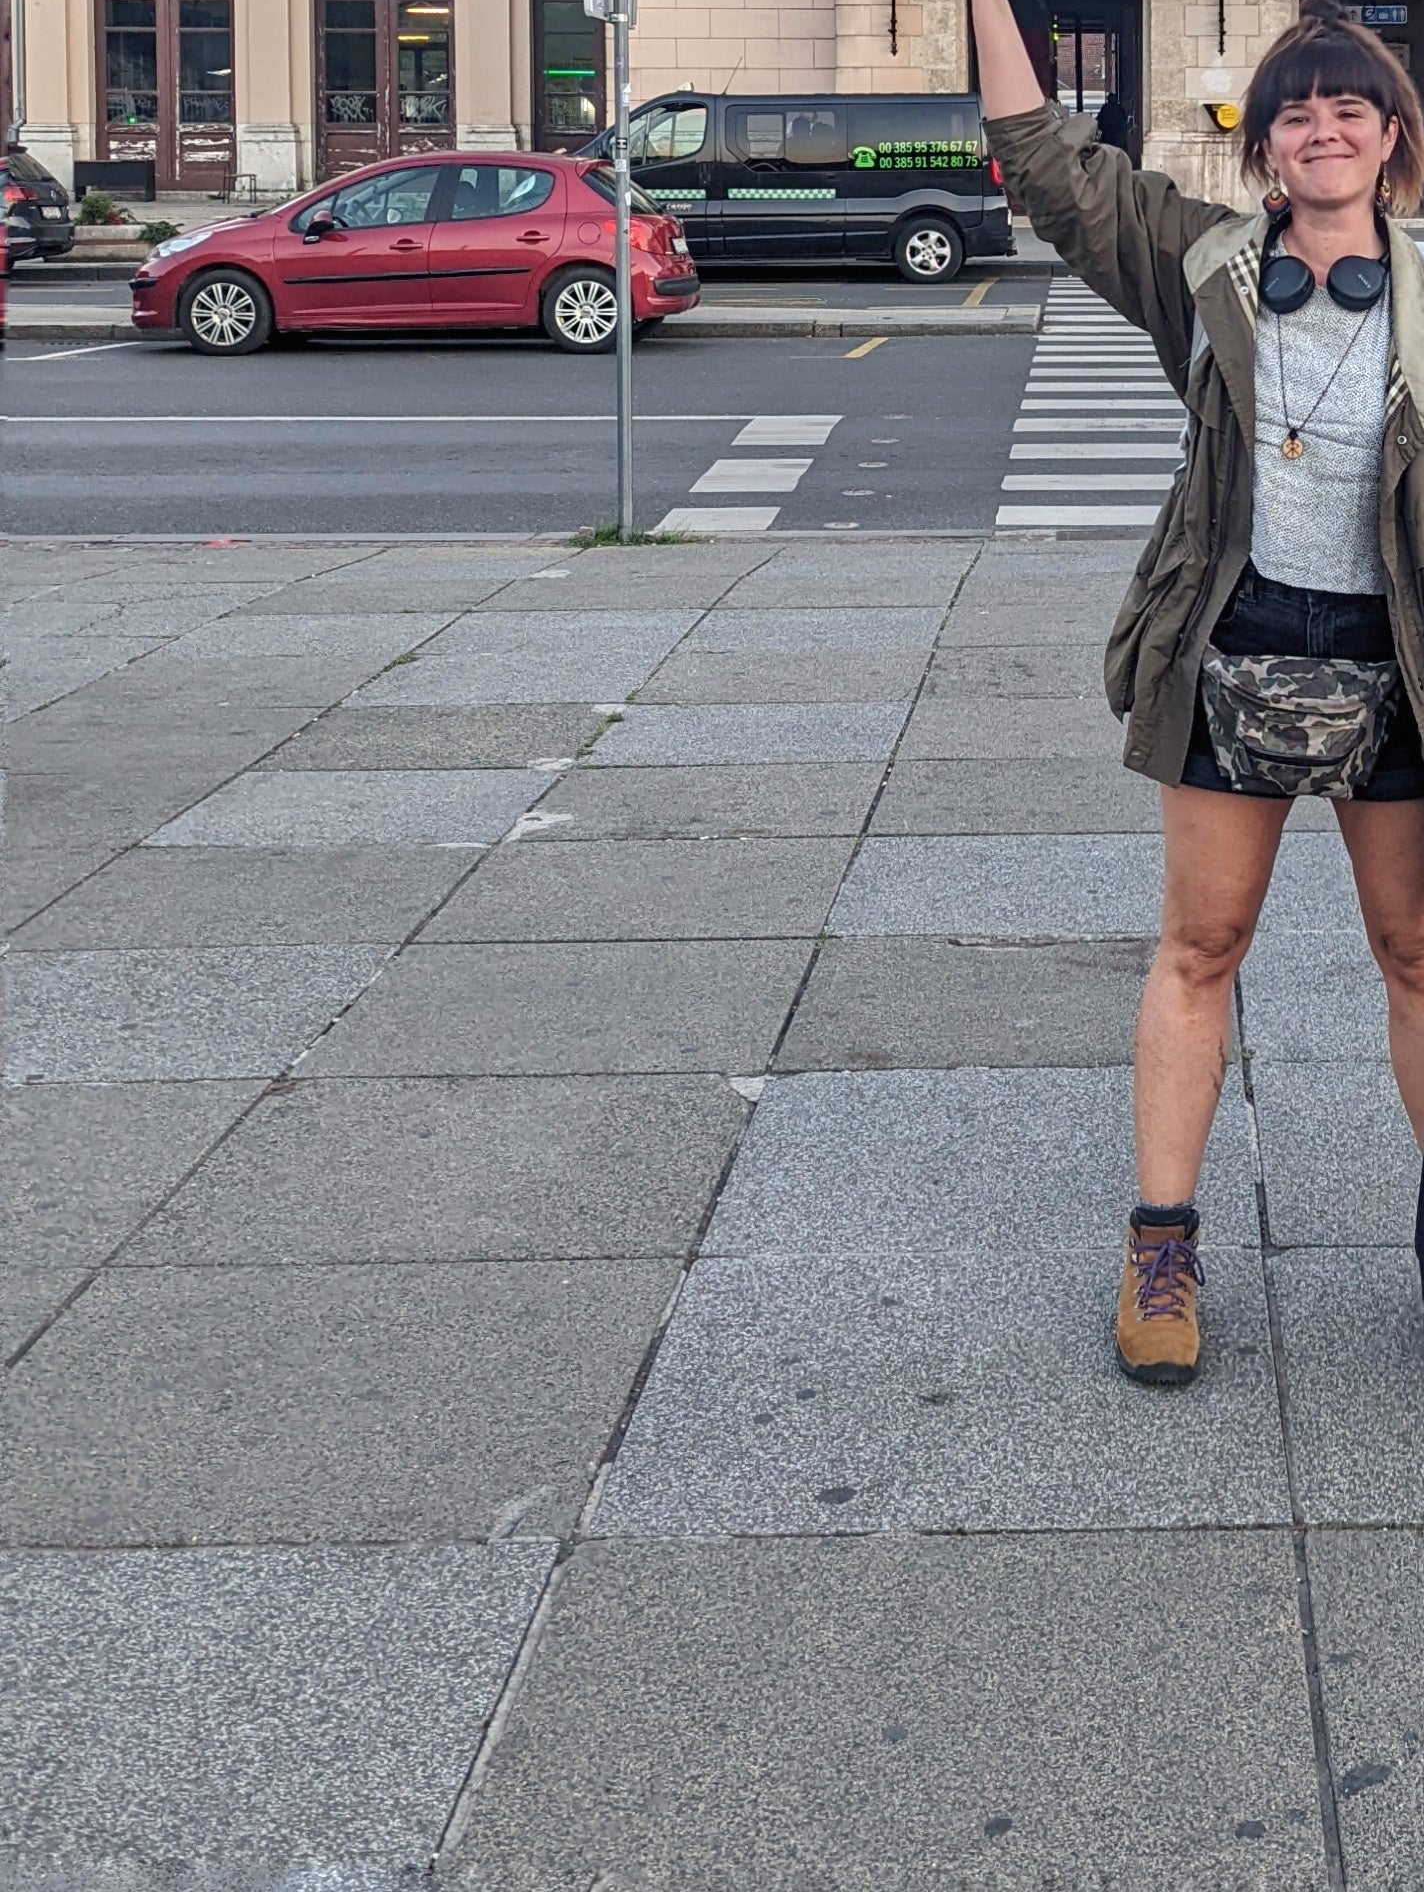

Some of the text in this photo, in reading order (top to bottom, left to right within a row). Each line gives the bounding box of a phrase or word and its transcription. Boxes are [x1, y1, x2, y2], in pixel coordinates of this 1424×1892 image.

[879, 140, 978, 153] 00 385 95 376 67 67
[879, 155, 978, 168] 00 385 91 542 80 75
